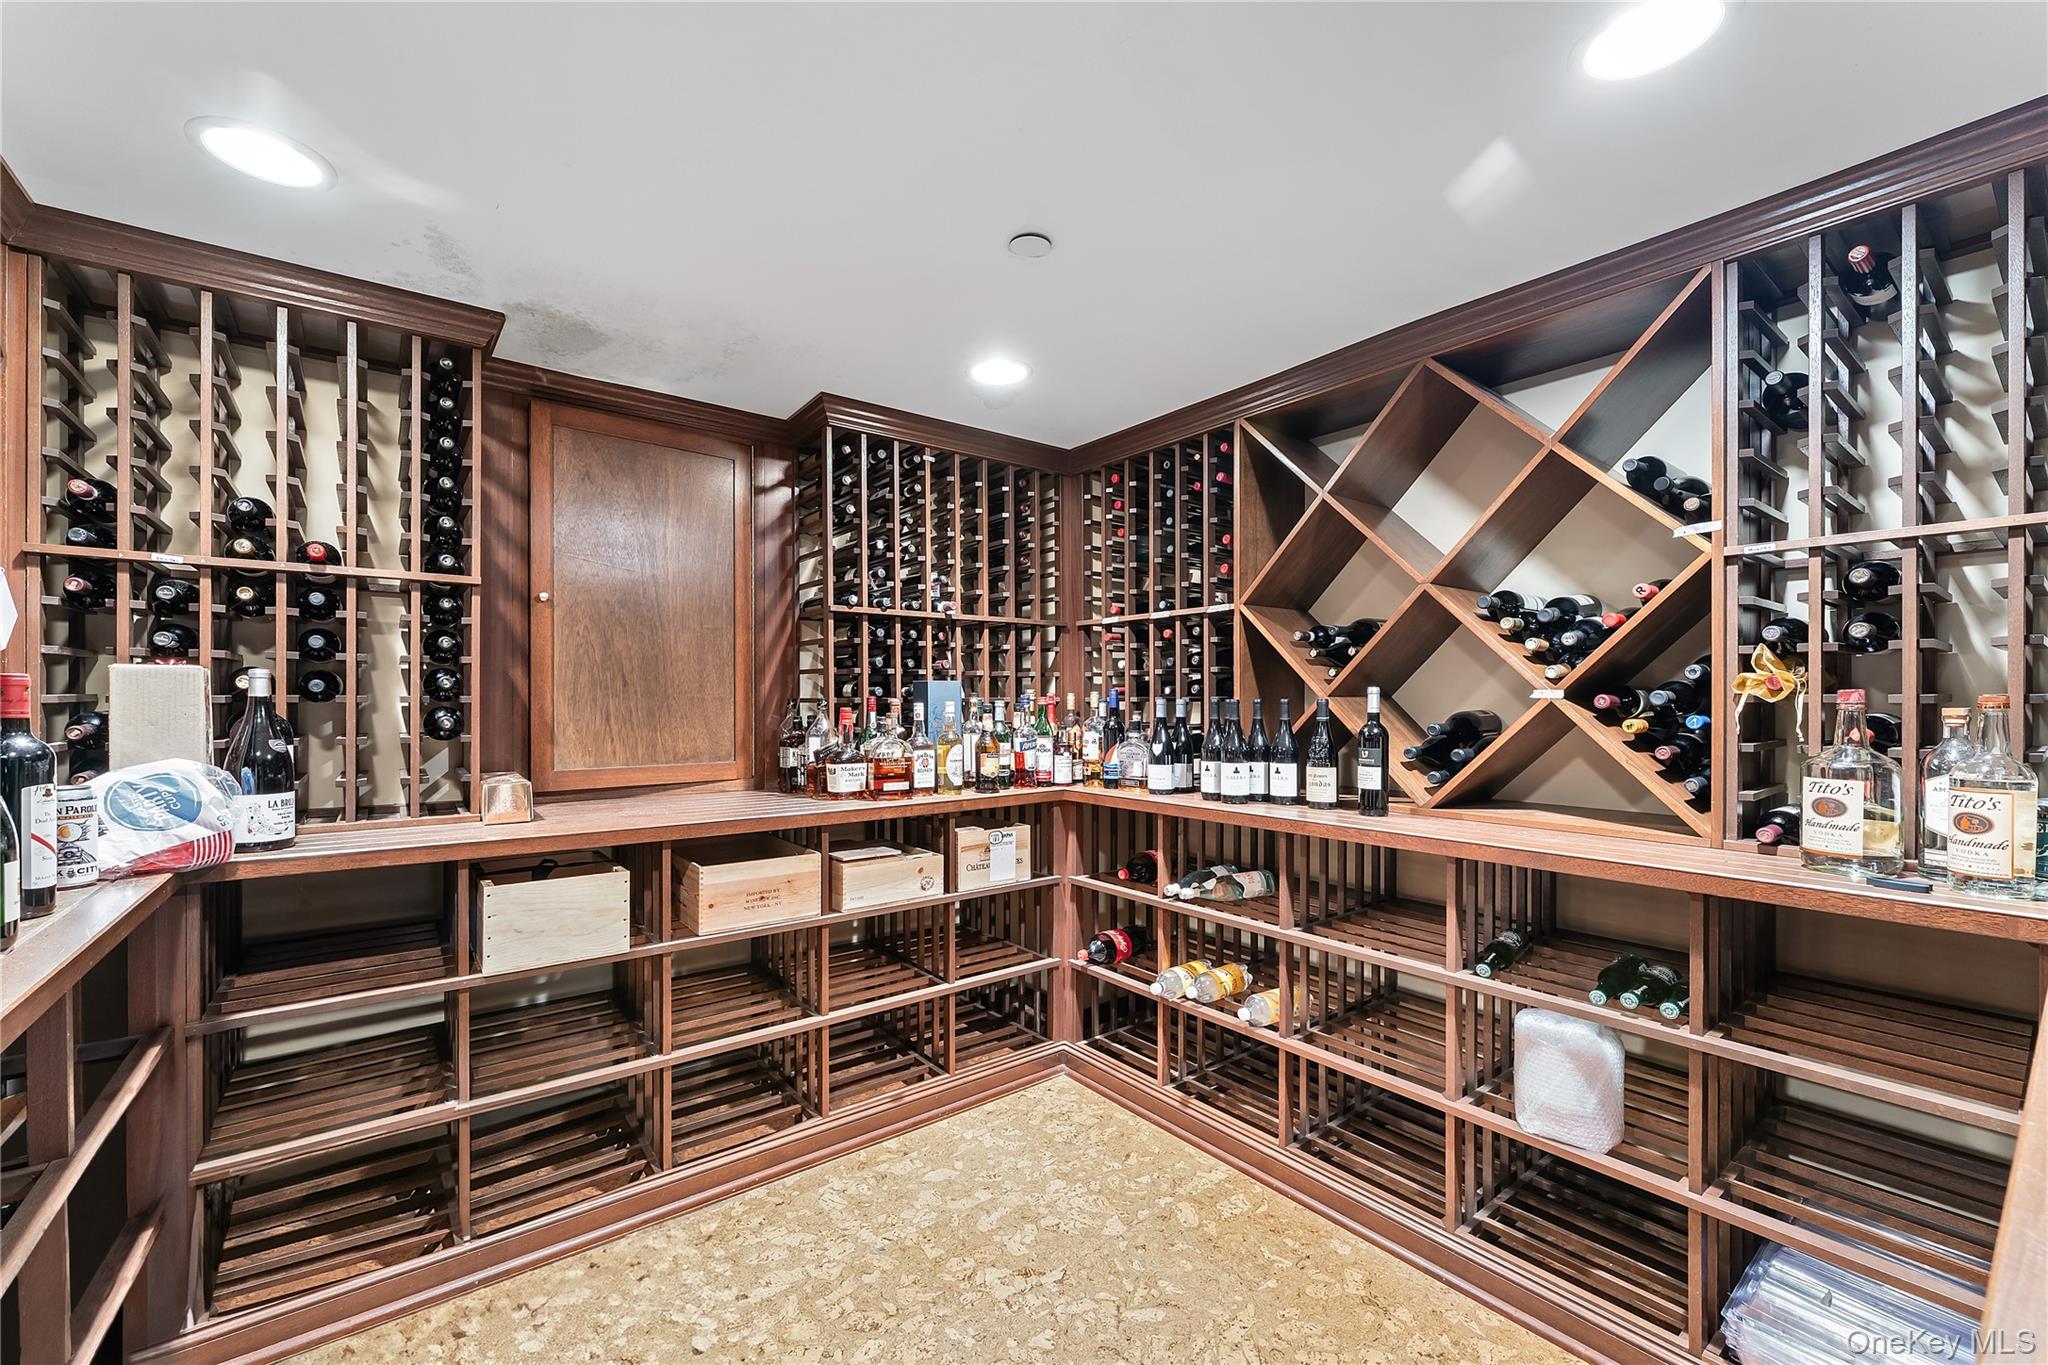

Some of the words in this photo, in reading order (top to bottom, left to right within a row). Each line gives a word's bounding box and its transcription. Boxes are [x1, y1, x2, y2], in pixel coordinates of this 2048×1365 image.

[1808, 781, 1854, 796] Tito's
[1950, 793, 2001, 811] Tito's
[1804, 817, 1861, 833] Handmade
[1948, 833, 2010, 851] Handmade
